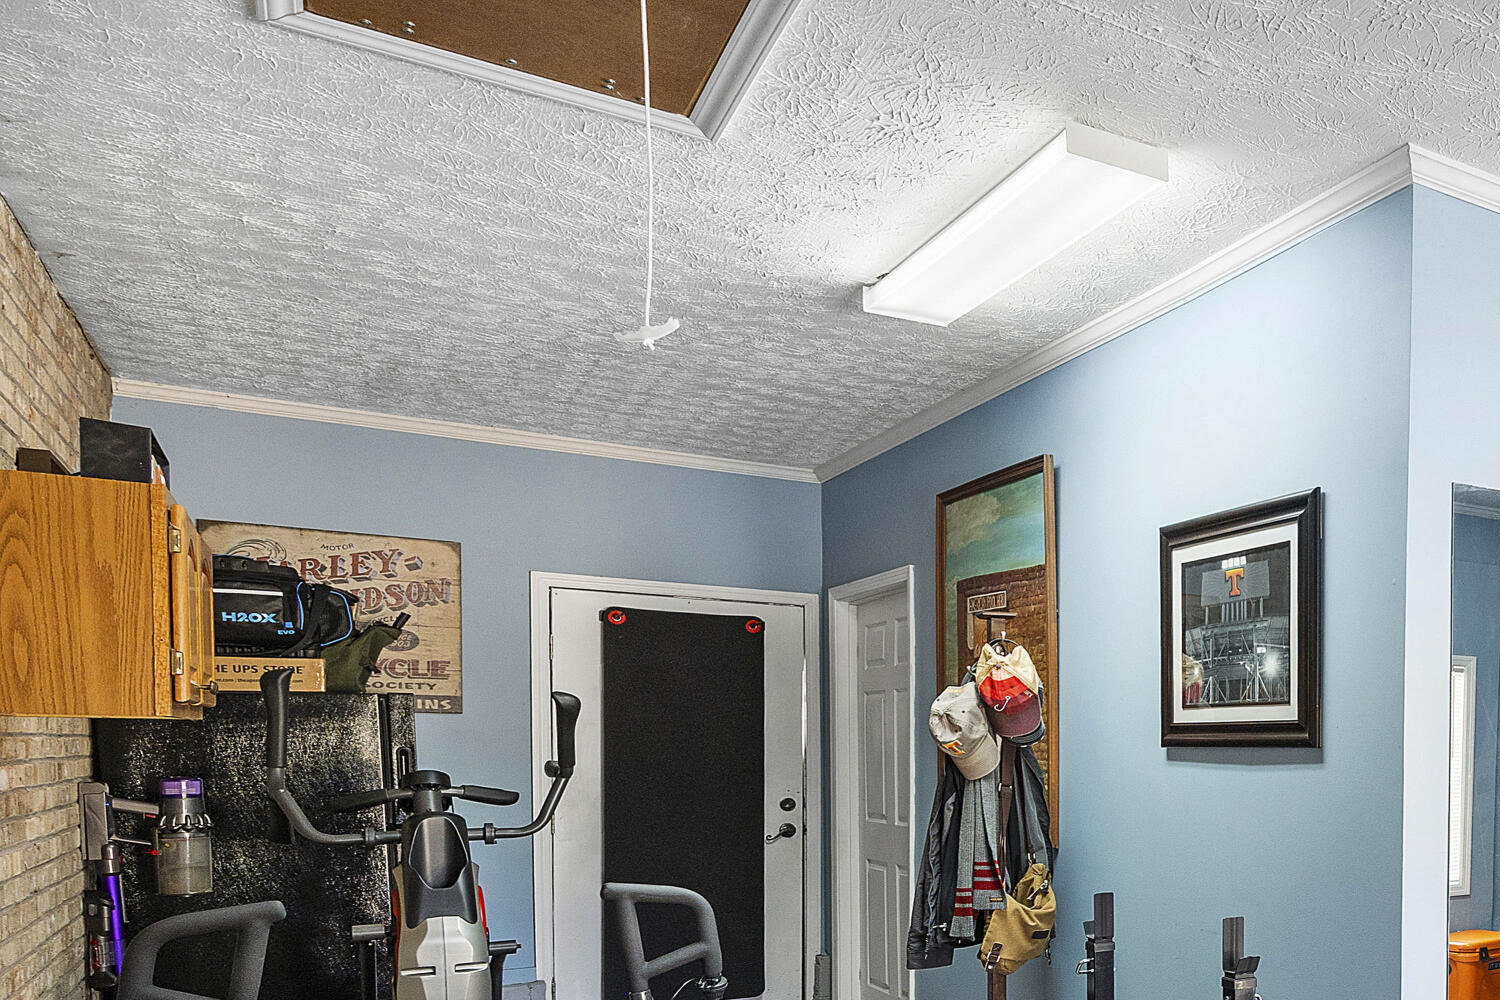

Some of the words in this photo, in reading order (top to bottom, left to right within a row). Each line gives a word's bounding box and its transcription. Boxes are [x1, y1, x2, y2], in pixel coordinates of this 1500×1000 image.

[320, 542, 354, 551] MOTOR
[1225, 567, 1244, 597] T
[214, 664, 229, 673] HE
[232, 664, 259, 673] UPS
